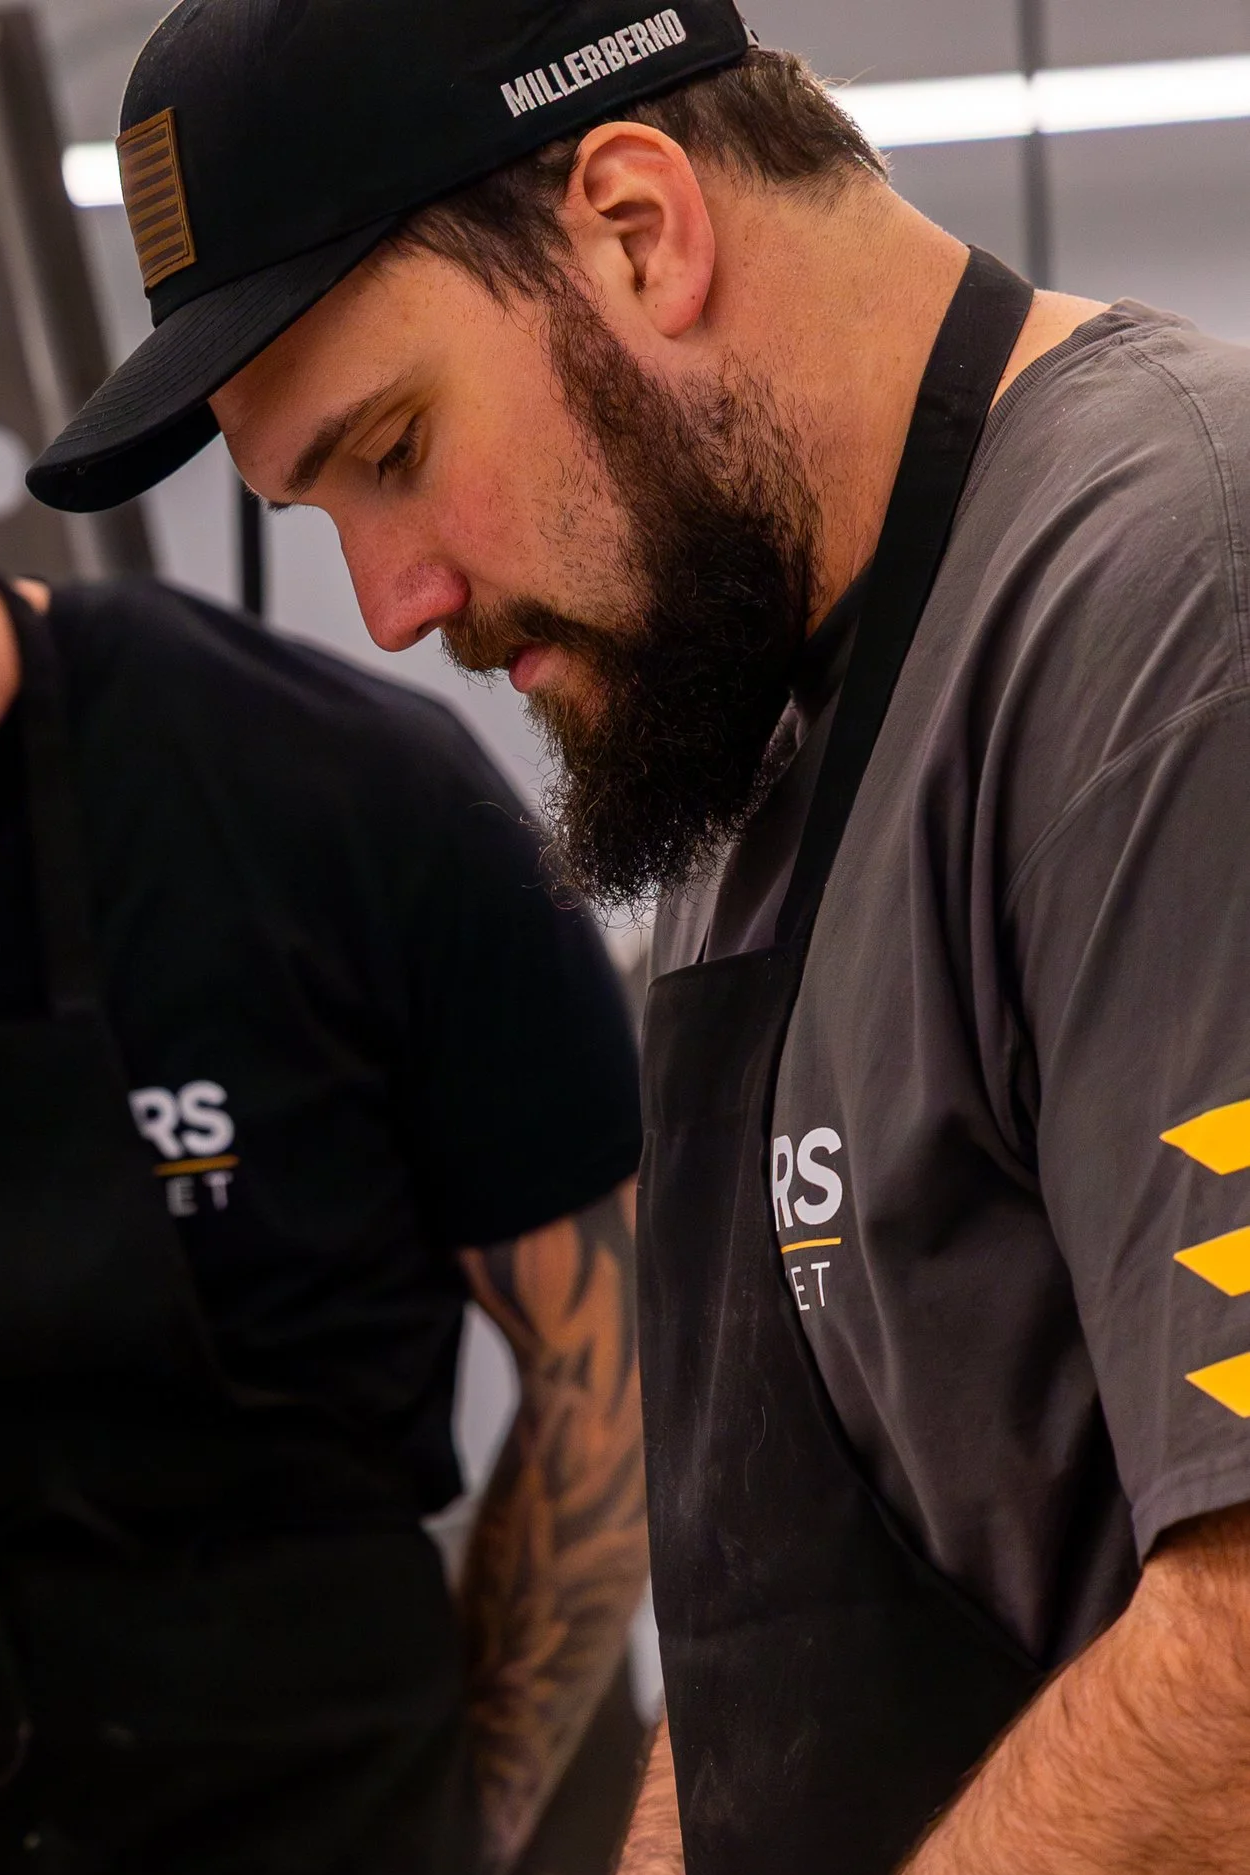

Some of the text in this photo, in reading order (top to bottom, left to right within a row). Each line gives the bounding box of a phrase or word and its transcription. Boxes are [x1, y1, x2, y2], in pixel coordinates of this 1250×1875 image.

[500, 8, 686, 117] MILLERBERND
[772, 1127, 843, 1232] RS
[786, 1261, 831, 1311] ET
